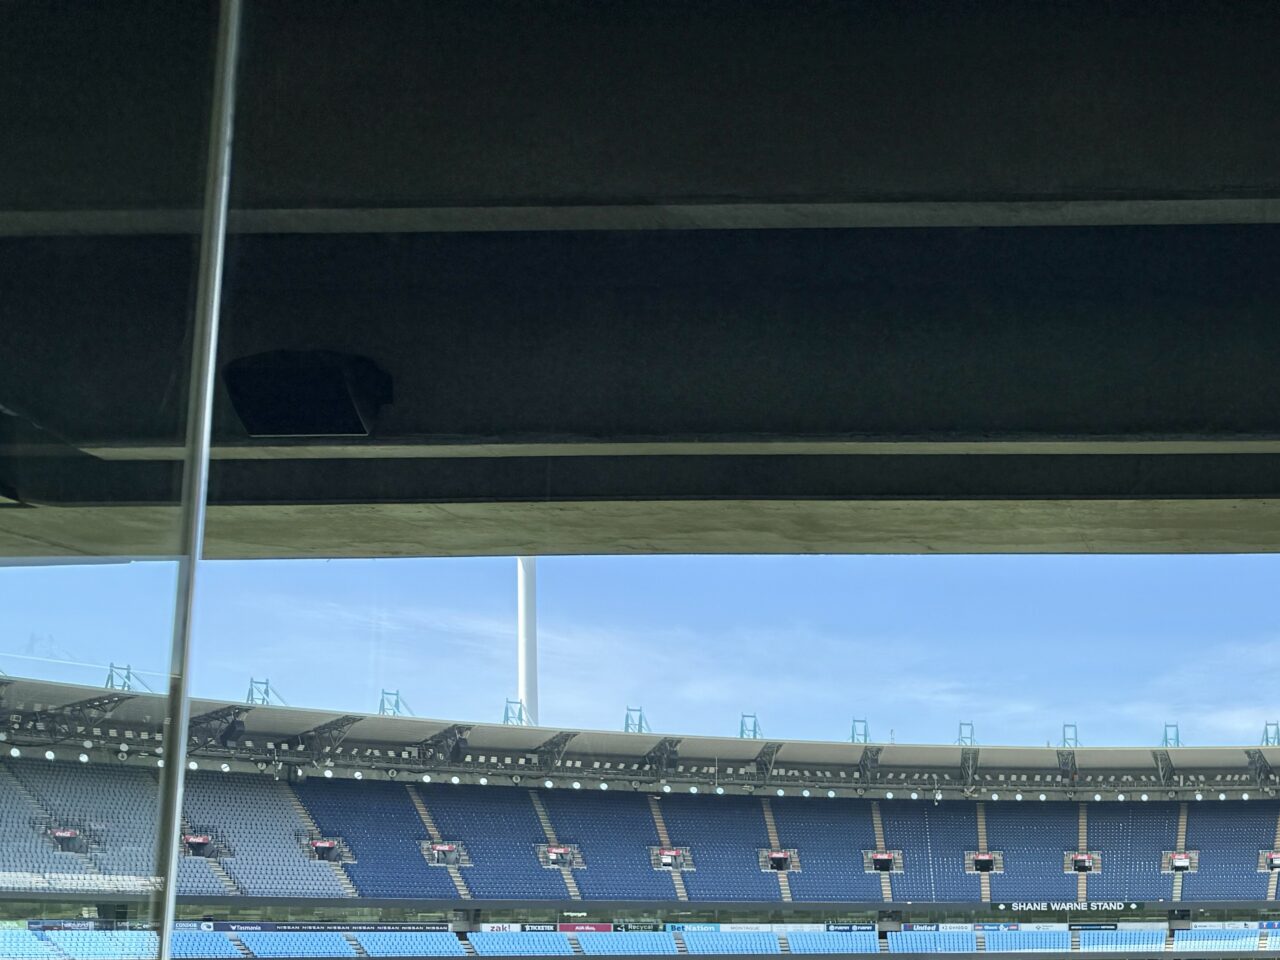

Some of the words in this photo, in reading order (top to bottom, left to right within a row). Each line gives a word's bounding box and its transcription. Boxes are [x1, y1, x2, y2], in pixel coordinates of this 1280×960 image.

[1011, 902, 1047, 911] SHANE
[1050, 902, 1088, 911] WARNE
[1090, 902, 1124, 911] STAND
